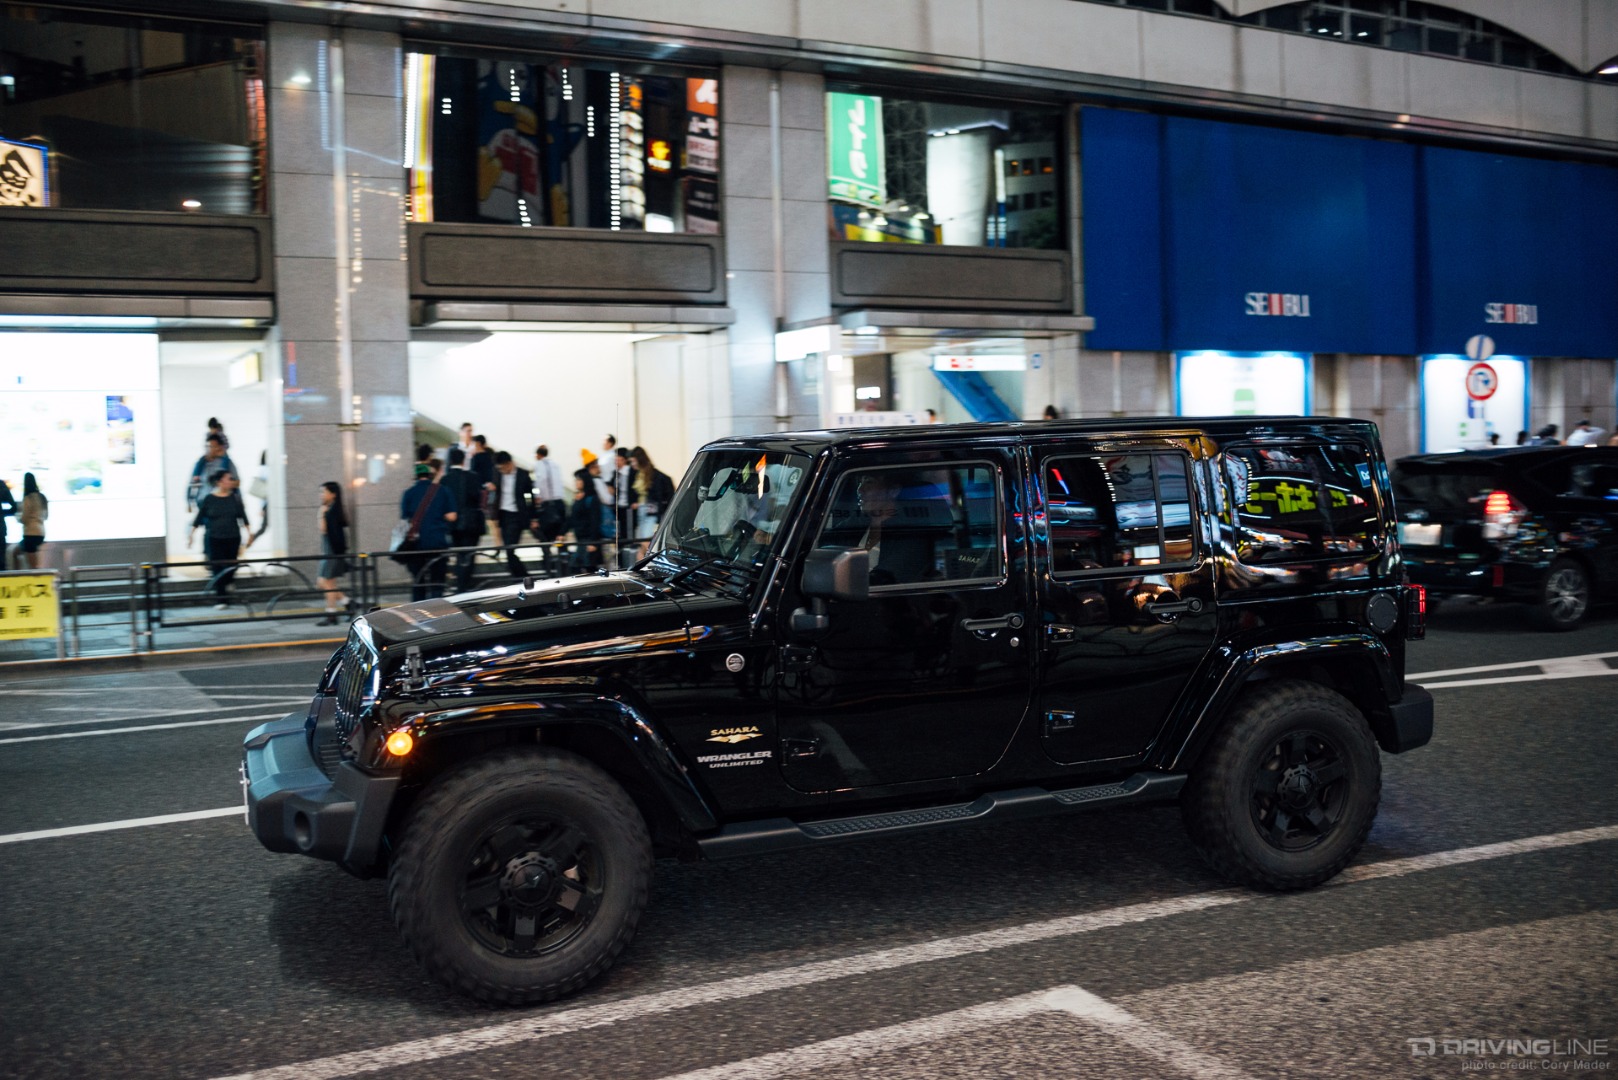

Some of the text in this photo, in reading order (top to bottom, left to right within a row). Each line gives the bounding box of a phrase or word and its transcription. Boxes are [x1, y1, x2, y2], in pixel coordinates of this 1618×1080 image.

[1244, 292, 1311, 317] SEIBU
[1484, 302, 1539, 325] SEIBU
[710, 726, 759, 735] SAHARA
[696, 750, 772, 763] WRANGLER
[708, 759, 764, 769] UNLIMITED
